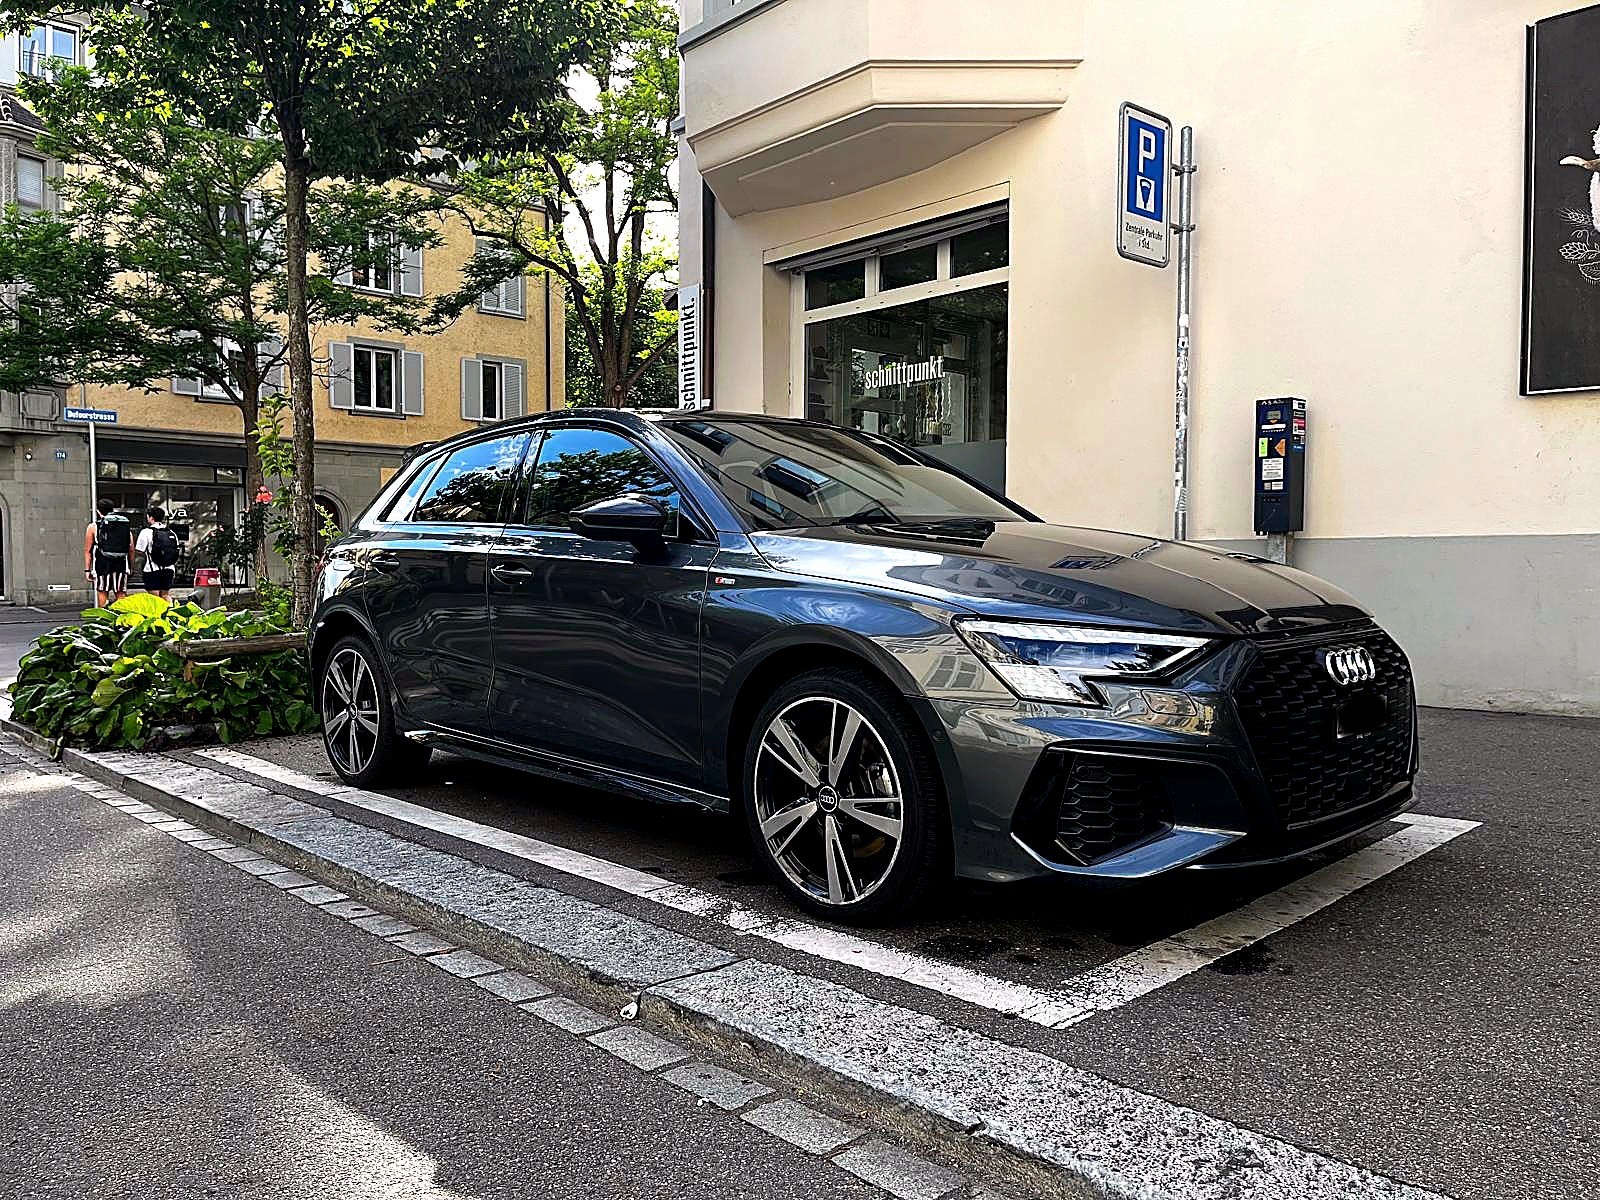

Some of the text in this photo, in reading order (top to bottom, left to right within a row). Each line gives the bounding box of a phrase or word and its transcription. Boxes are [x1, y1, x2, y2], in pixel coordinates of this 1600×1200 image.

[1138, 127, 1156, 174] P
[1125, 221, 1163, 241] Zentrale Parkuhr
[680, 297, 698, 410] schnittpunkt.
[864, 355, 946, 390] schnittpunkt.
[67, 410, 115, 421] Dufourstrasse
